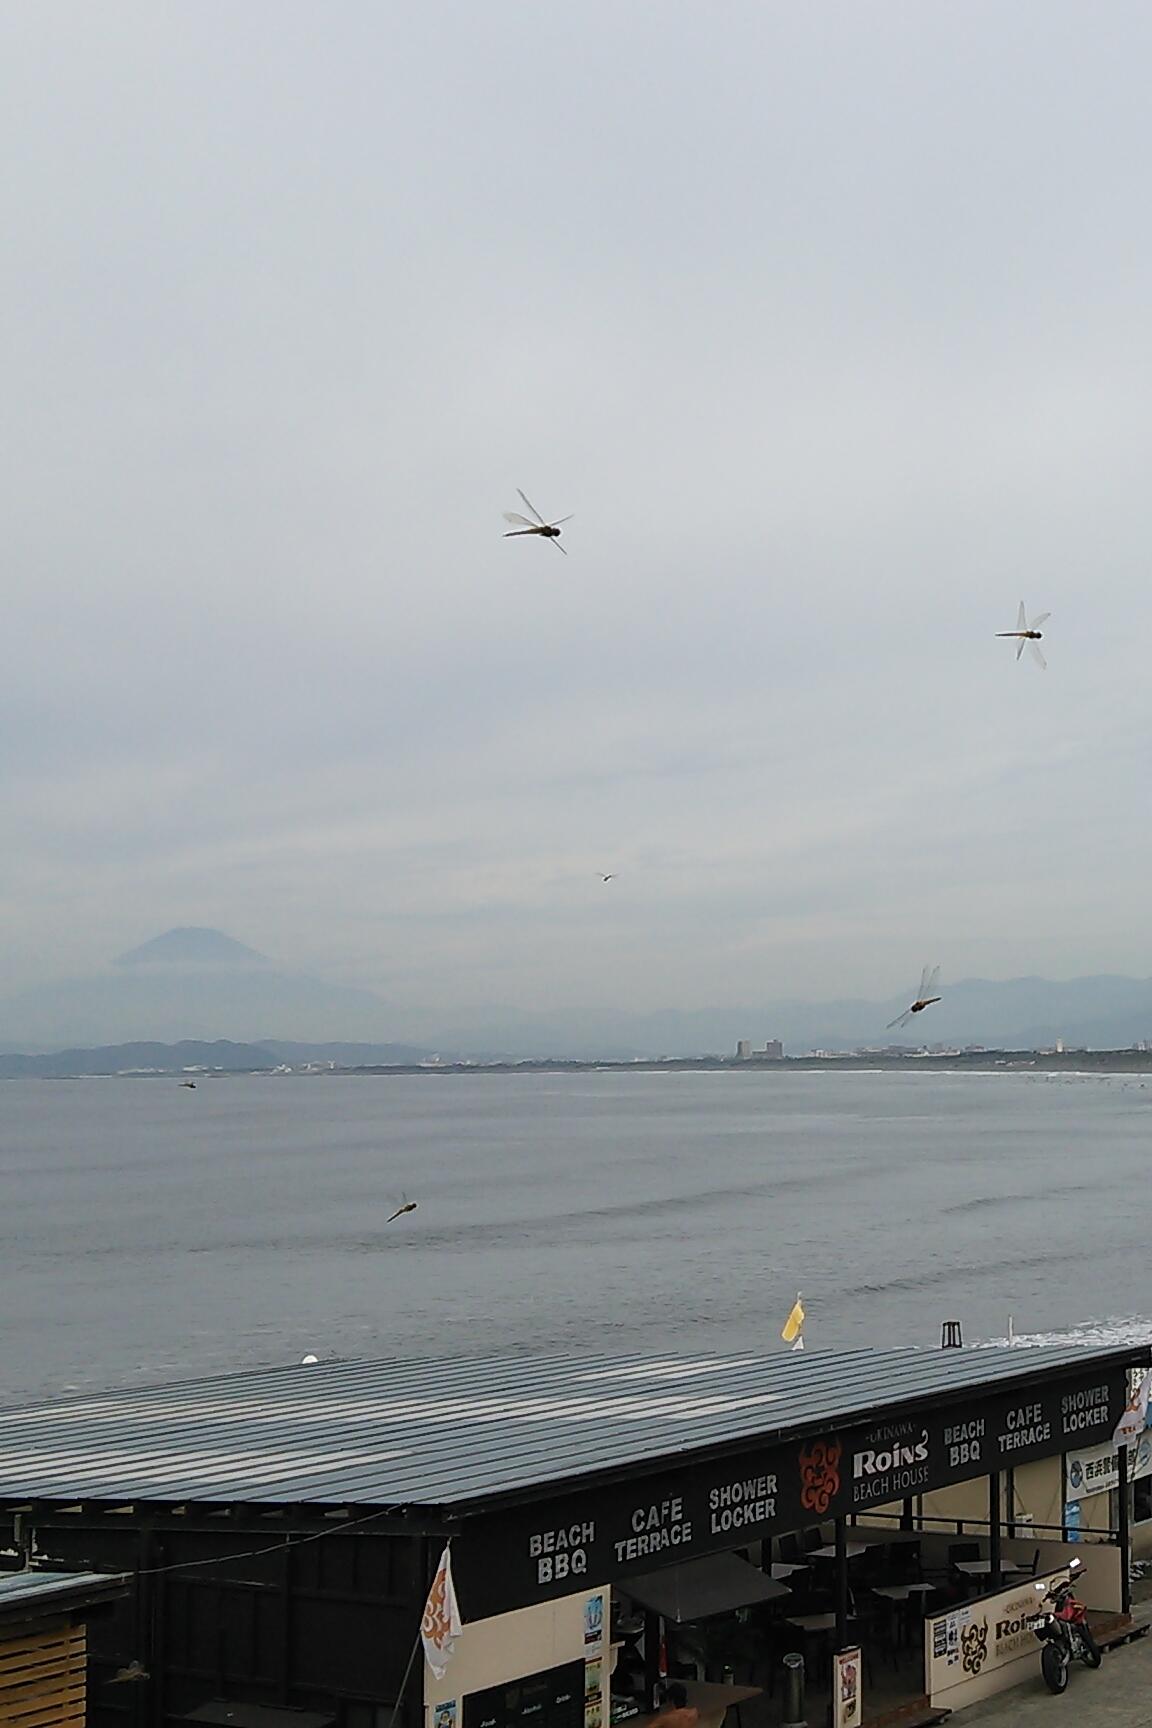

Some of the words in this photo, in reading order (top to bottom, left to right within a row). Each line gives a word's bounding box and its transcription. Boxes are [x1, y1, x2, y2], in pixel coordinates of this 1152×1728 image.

[1006, 1403, 1042, 1430] CAFE
[1061, 1385, 1109, 1414] SHOWER
[944, 1419, 985, 1445] BEACH
[998, 1422, 1051, 1452] TERRACE
[1063, 1405, 1109, 1434] LOCKER
[950, 1440, 981, 1467] BBQ
[709, 1474, 778, 1510] SHOWER
[854, 1476, 889, 1502] BEACH
[893, 1466, 929, 1491] HOUSE
[631, 1497, 683, 1533] CAFE
[711, 1498, 776, 1534] LOCKER
[529, 1521, 595, 1557] BEACH
[614, 1521, 692, 1562] TERRACE
[538, 1548, 587, 1584] BBQ
